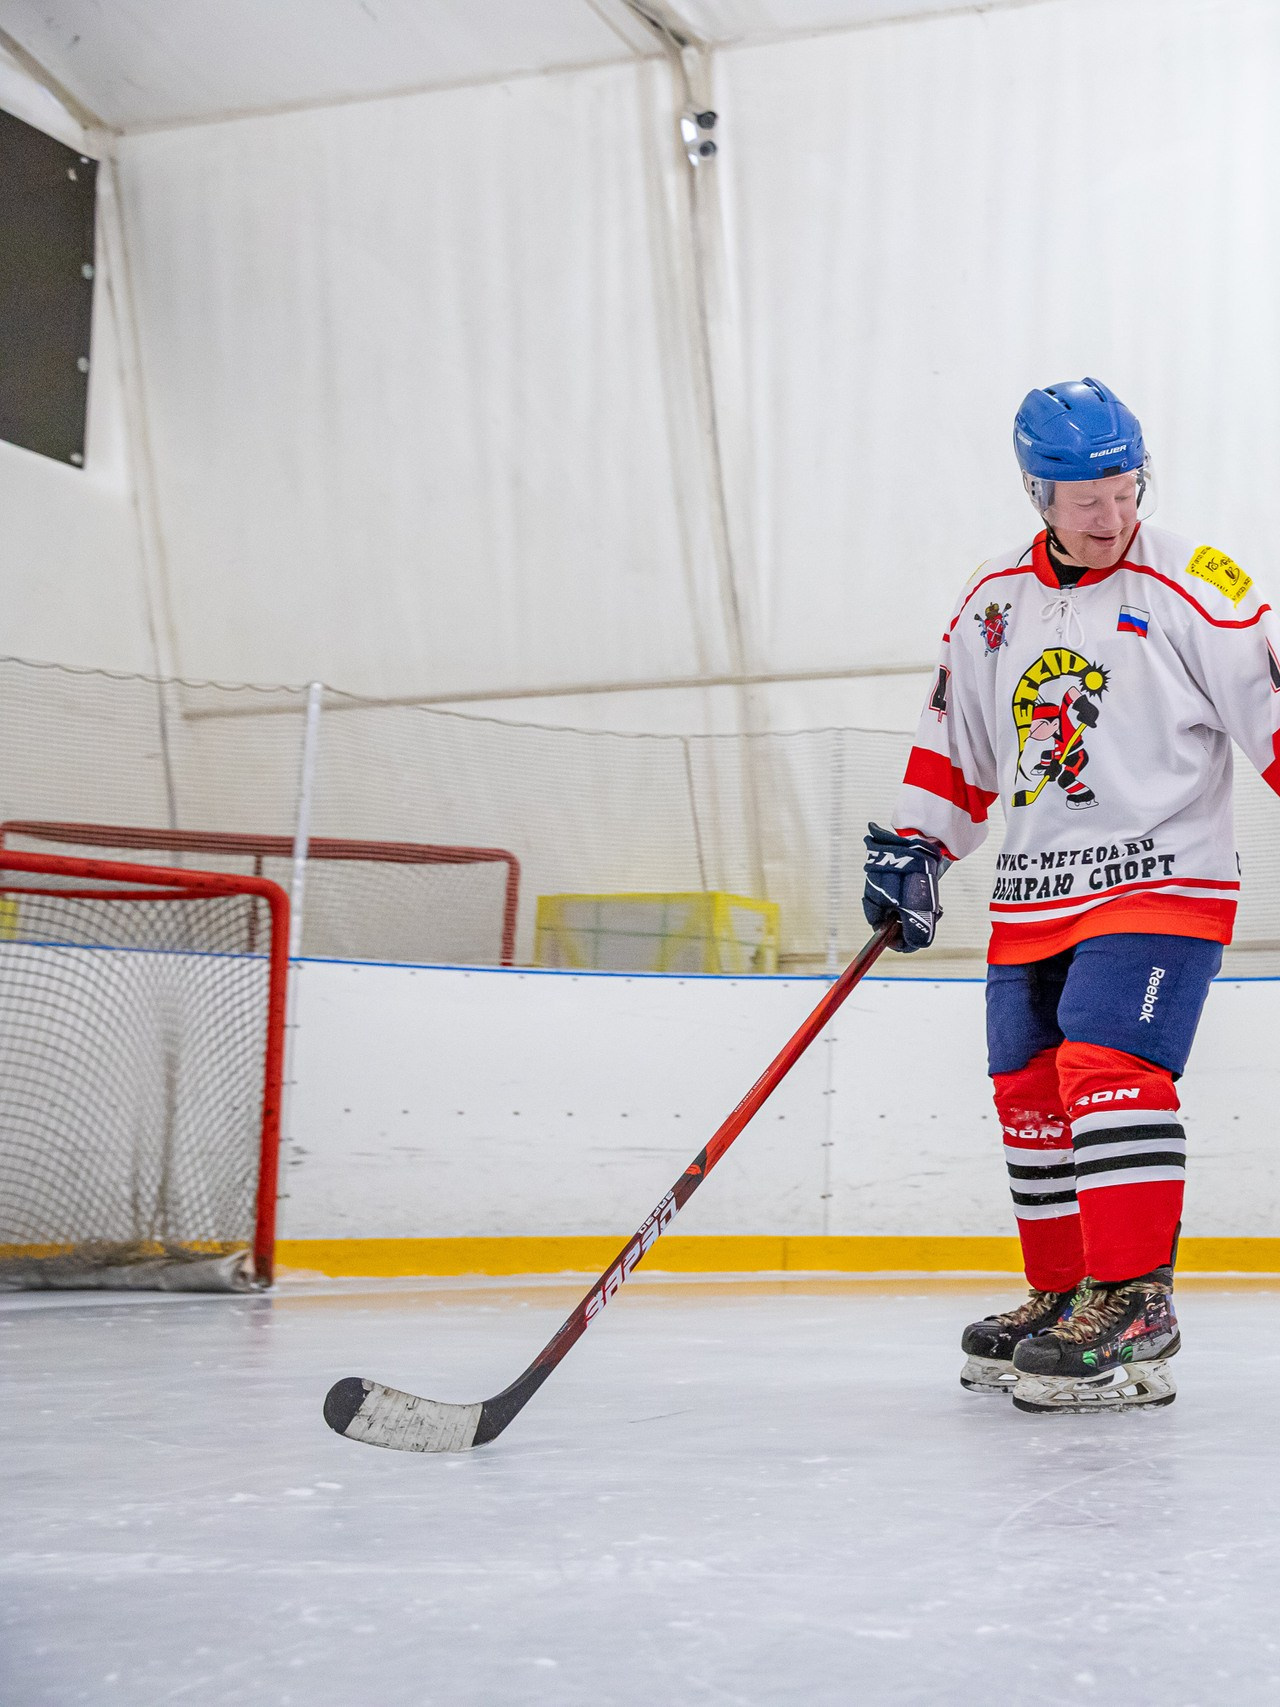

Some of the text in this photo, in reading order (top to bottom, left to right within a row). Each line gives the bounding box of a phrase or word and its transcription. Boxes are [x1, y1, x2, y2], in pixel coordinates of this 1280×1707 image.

[866, 850, 914, 869] CM
[1089, 854, 1176, 890] СПОРТ
[1139, 966, 1166, 1024] Reebok
